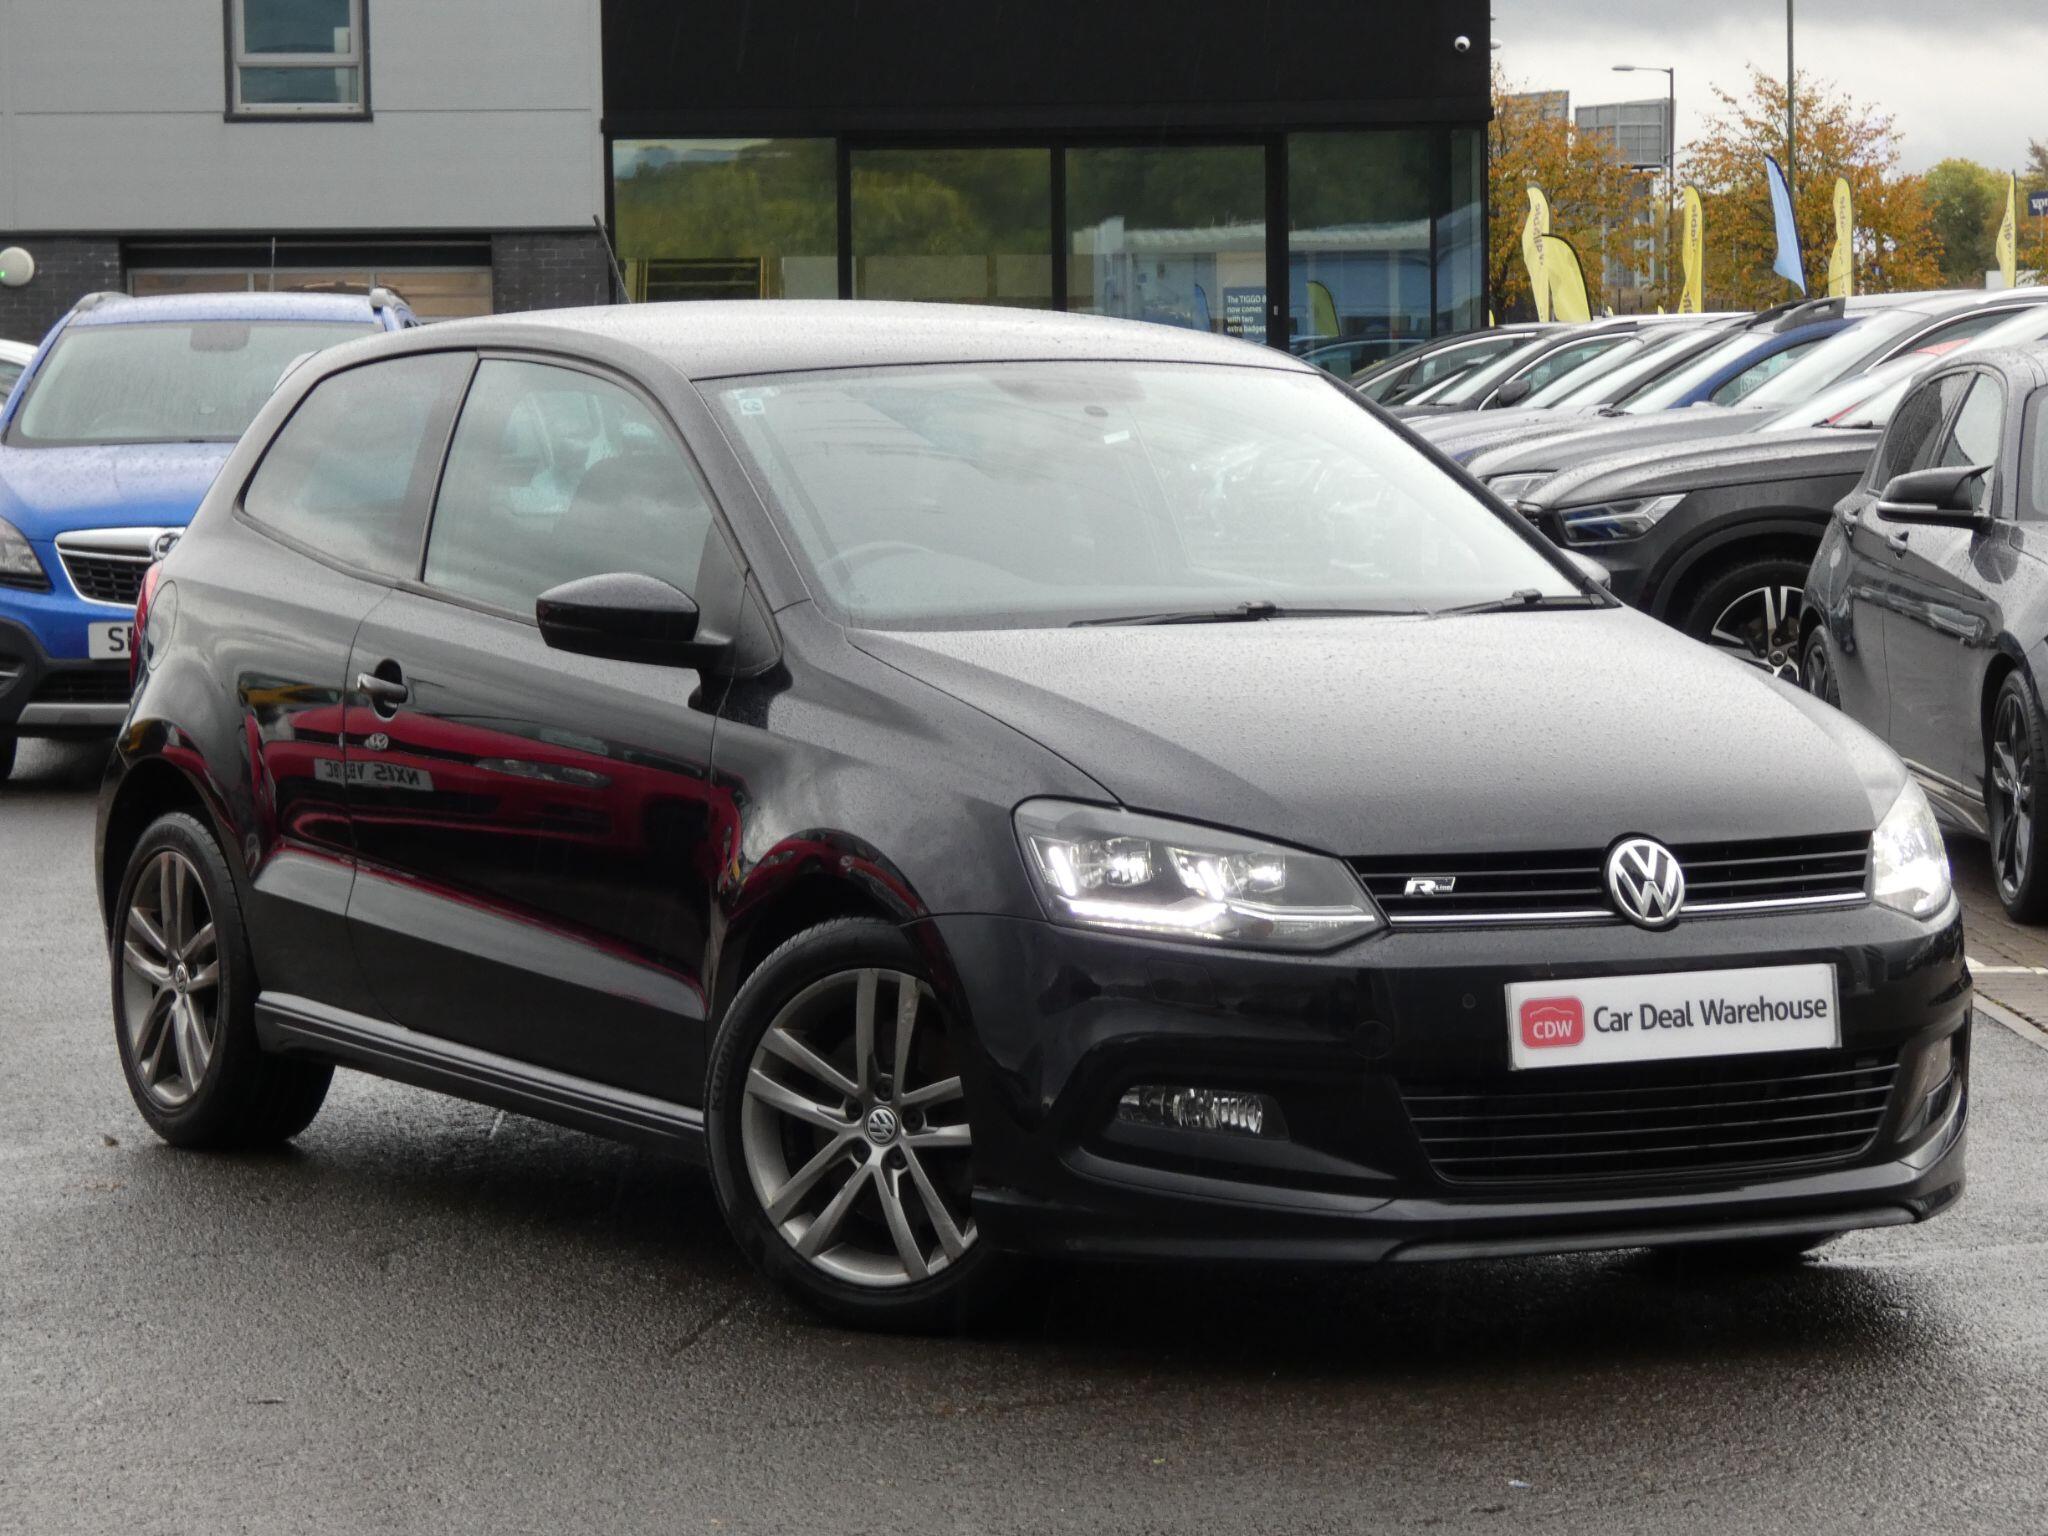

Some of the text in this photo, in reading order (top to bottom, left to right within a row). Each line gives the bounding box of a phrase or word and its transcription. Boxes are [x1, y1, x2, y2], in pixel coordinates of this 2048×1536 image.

[1227, 295, 1238, 303] The
[1239, 295, 1260, 303] TIGGO
[1227, 315, 1240, 323] with
[1404, 880, 1434, 896] R
[1593, 996, 1827, 1033] Car Deal Warehouse
[1532, 1019, 1573, 1039] CDW
